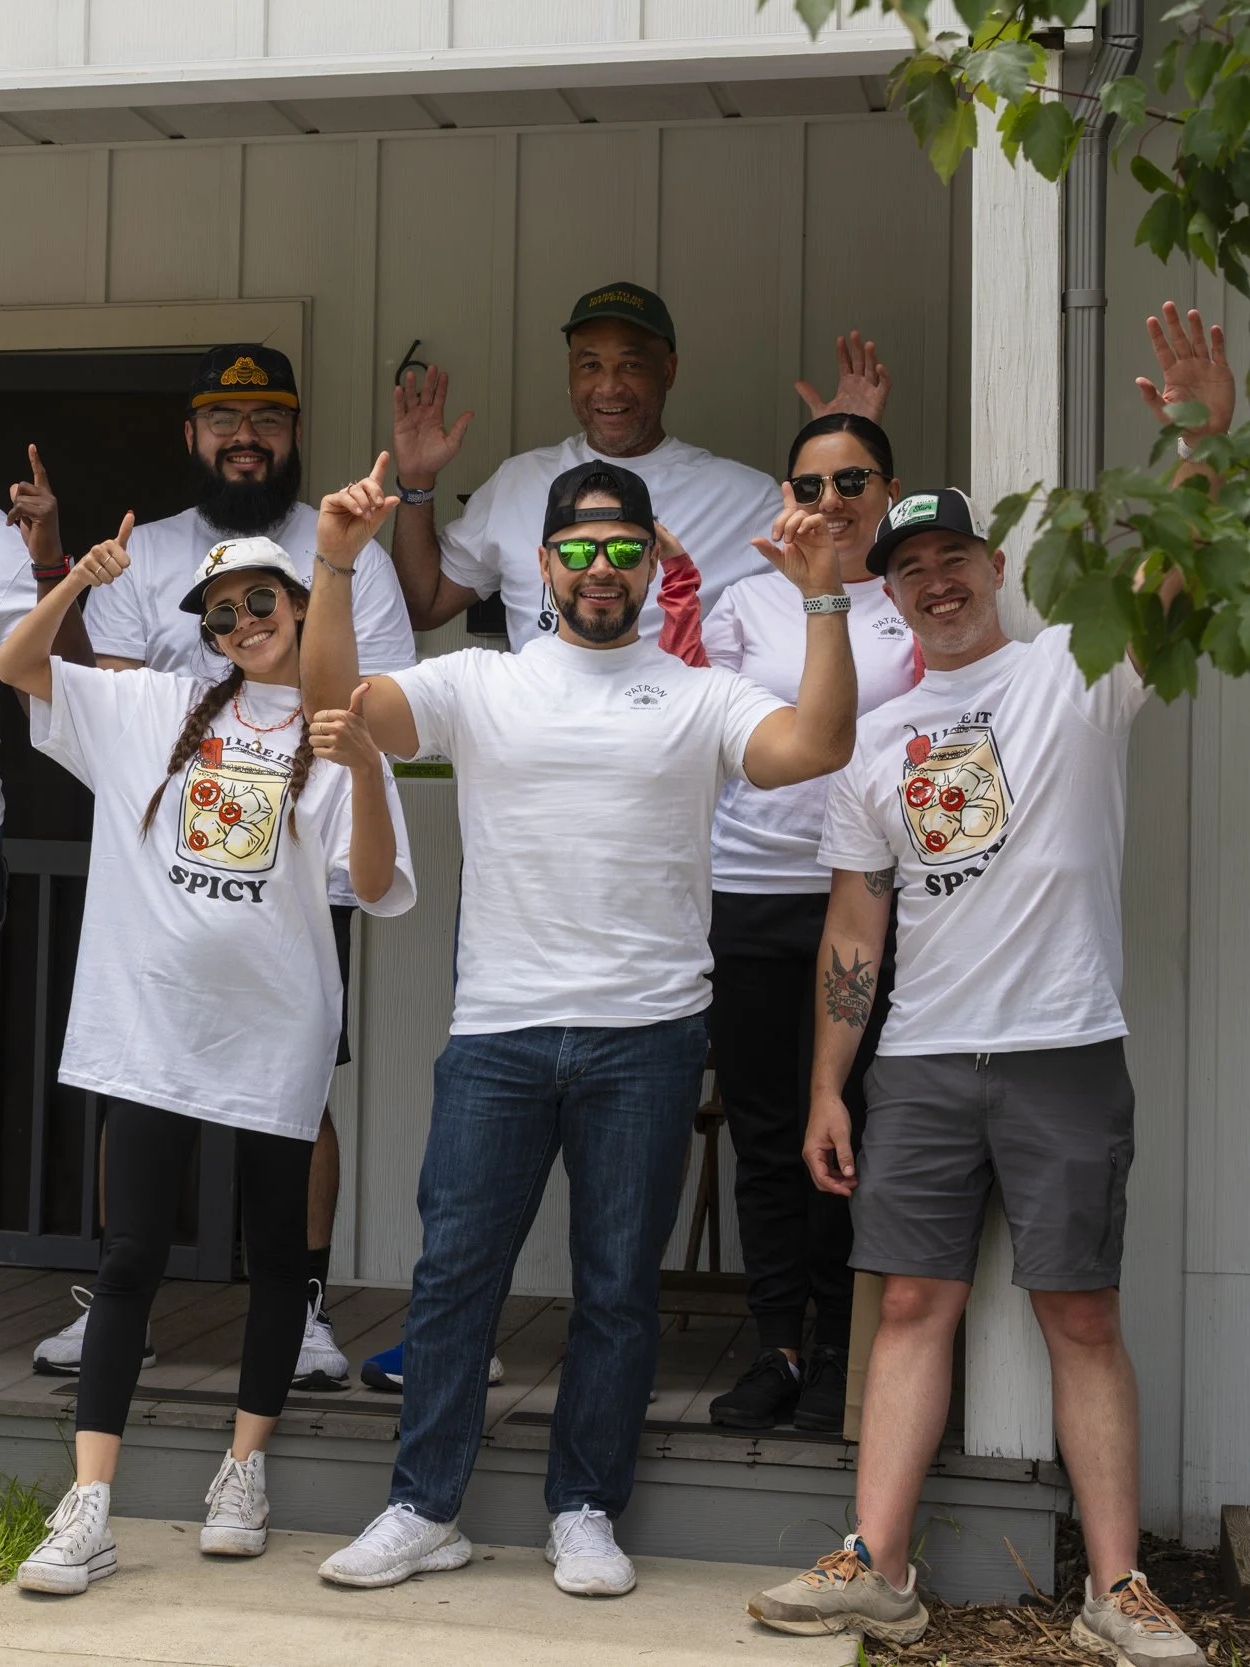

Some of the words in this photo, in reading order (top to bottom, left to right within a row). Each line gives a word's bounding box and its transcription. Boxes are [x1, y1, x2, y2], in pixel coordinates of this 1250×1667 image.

[974, 712, 992, 723] IT
[225, 736, 232, 746] I
[235, 737, 274, 758] LIE
[168, 864, 268, 903] SPICY
